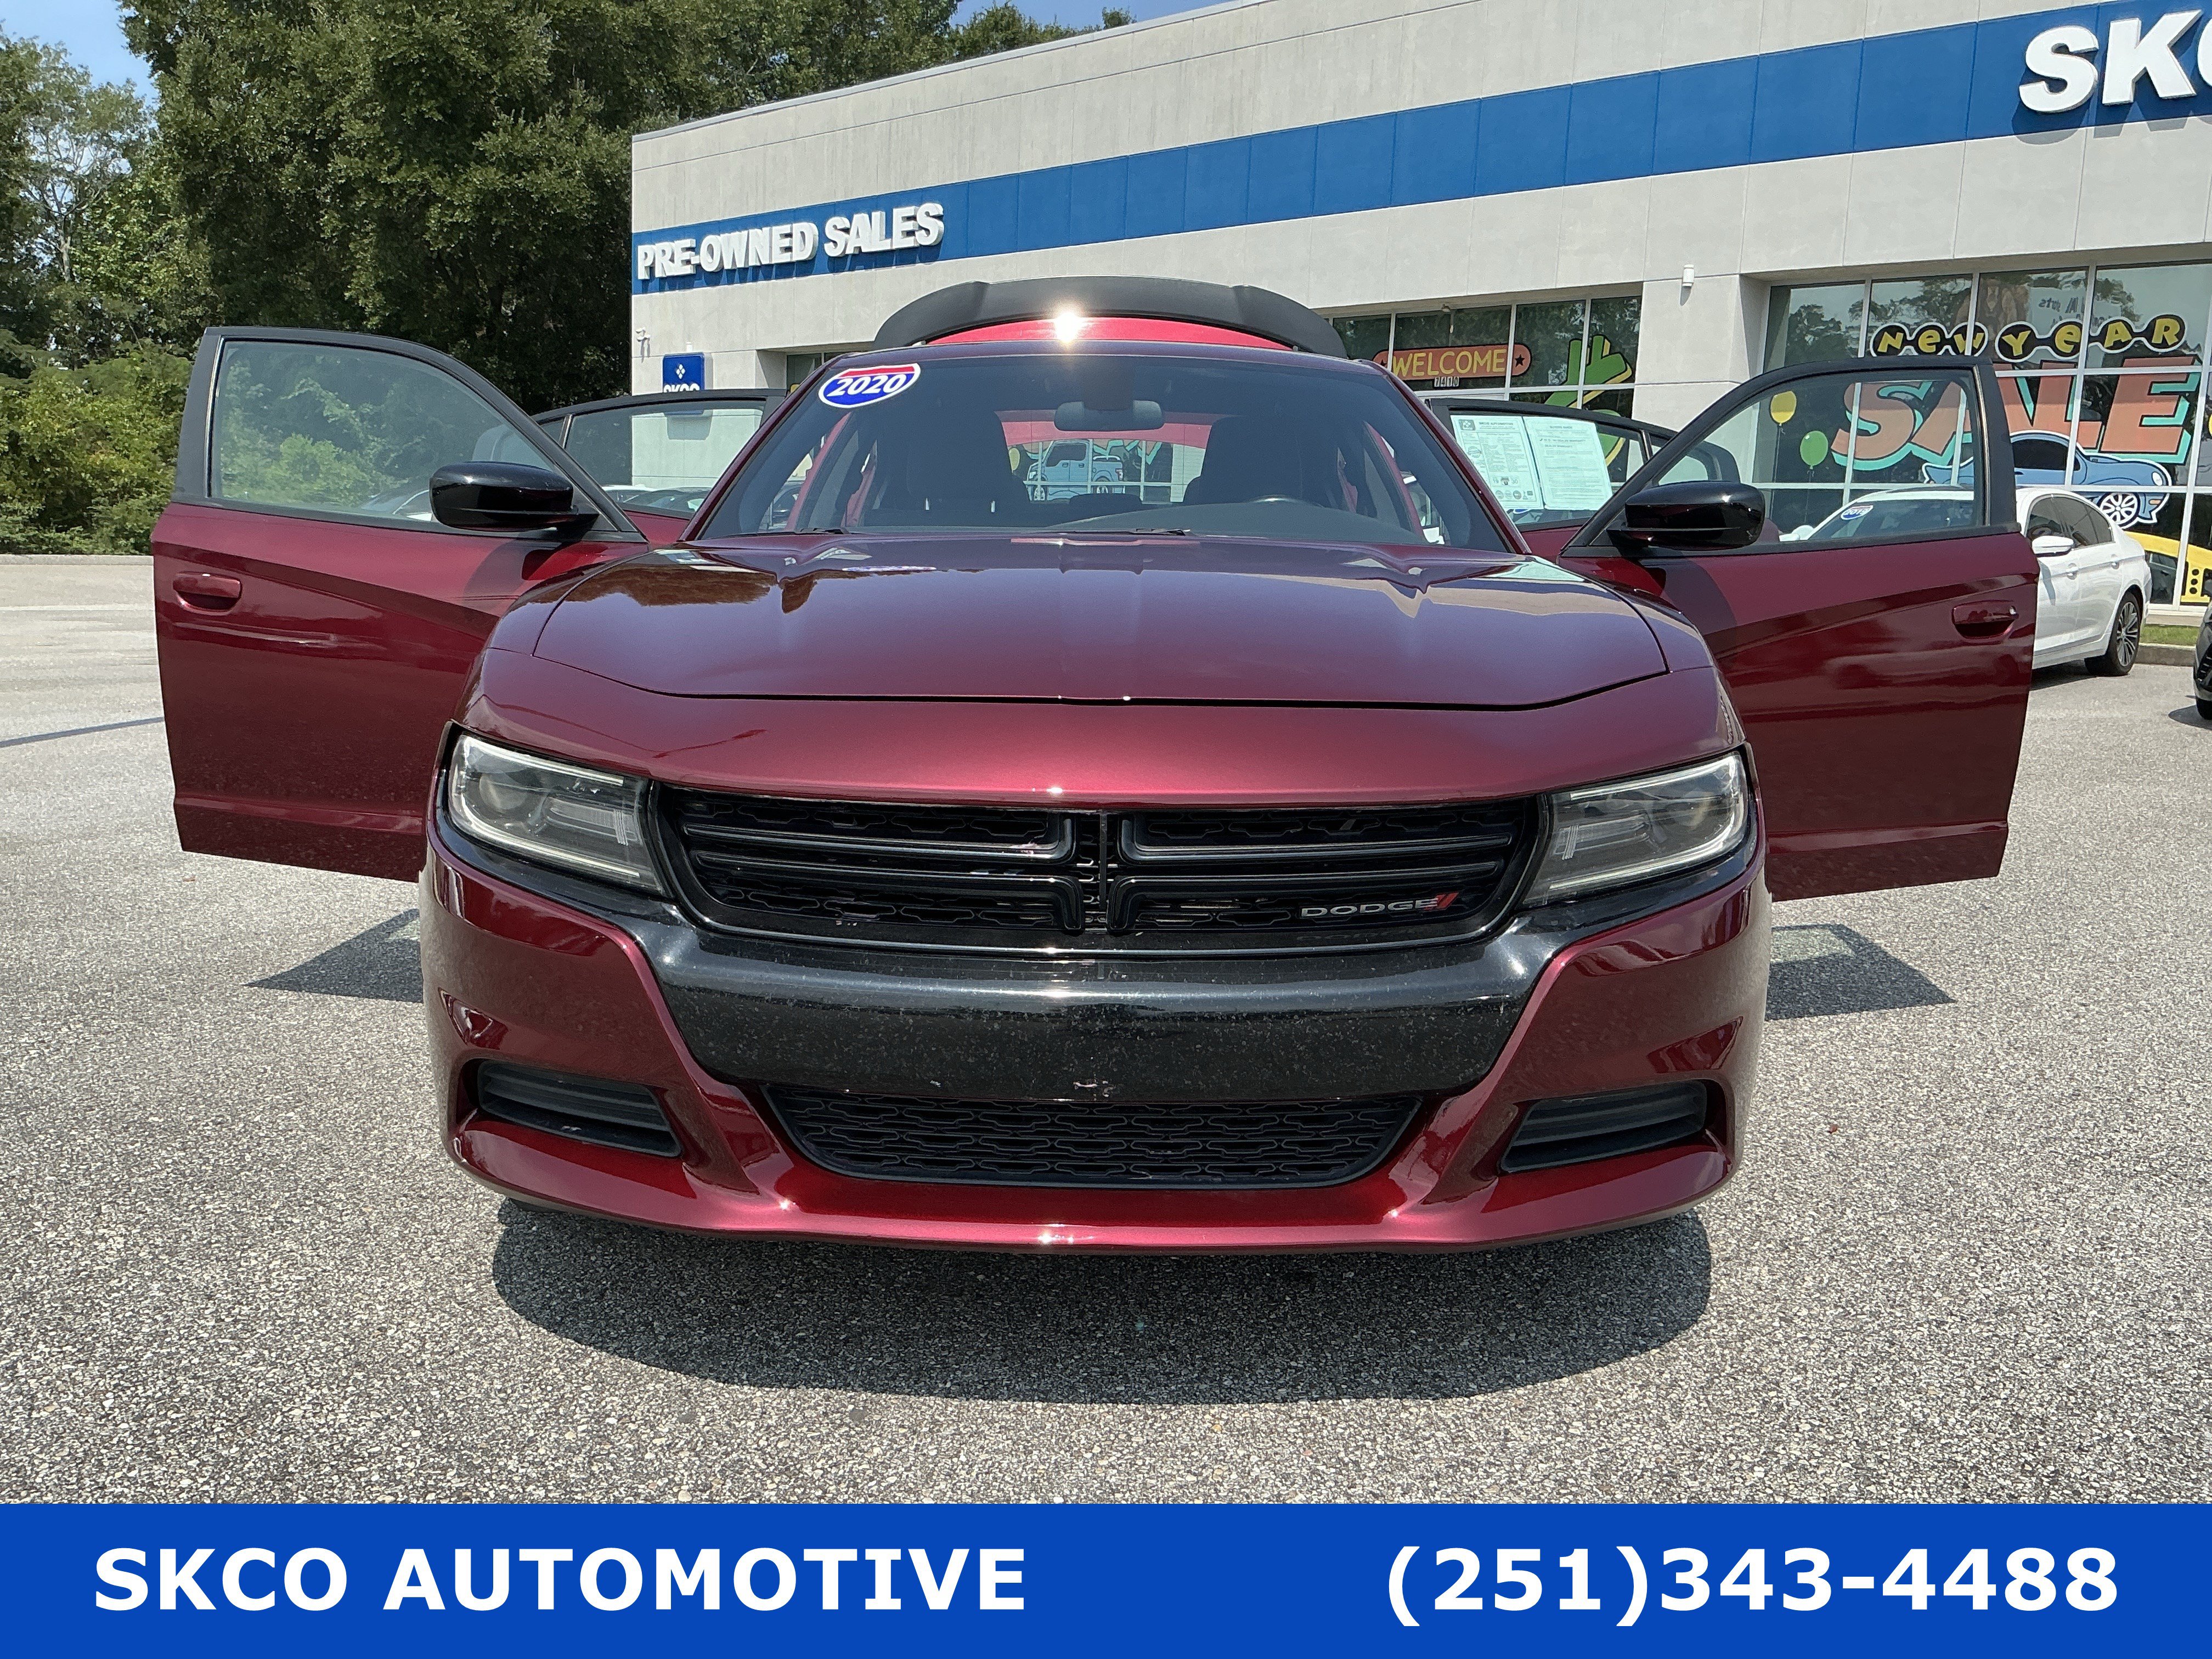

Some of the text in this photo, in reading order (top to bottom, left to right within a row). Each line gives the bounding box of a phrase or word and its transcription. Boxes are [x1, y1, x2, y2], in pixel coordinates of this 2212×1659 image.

[2019, 9, 2211, 113] SK
[638, 202, 944, 280] PRE-OWNED SALES
[1392, 349, 1507, 377] WELCOME
[826, 374, 907, 397] 2020
[1435, 376, 1459, 387] 7410
[1831, 356, 2202, 471] SALE
[1301, 898, 1438, 917] DODGE
